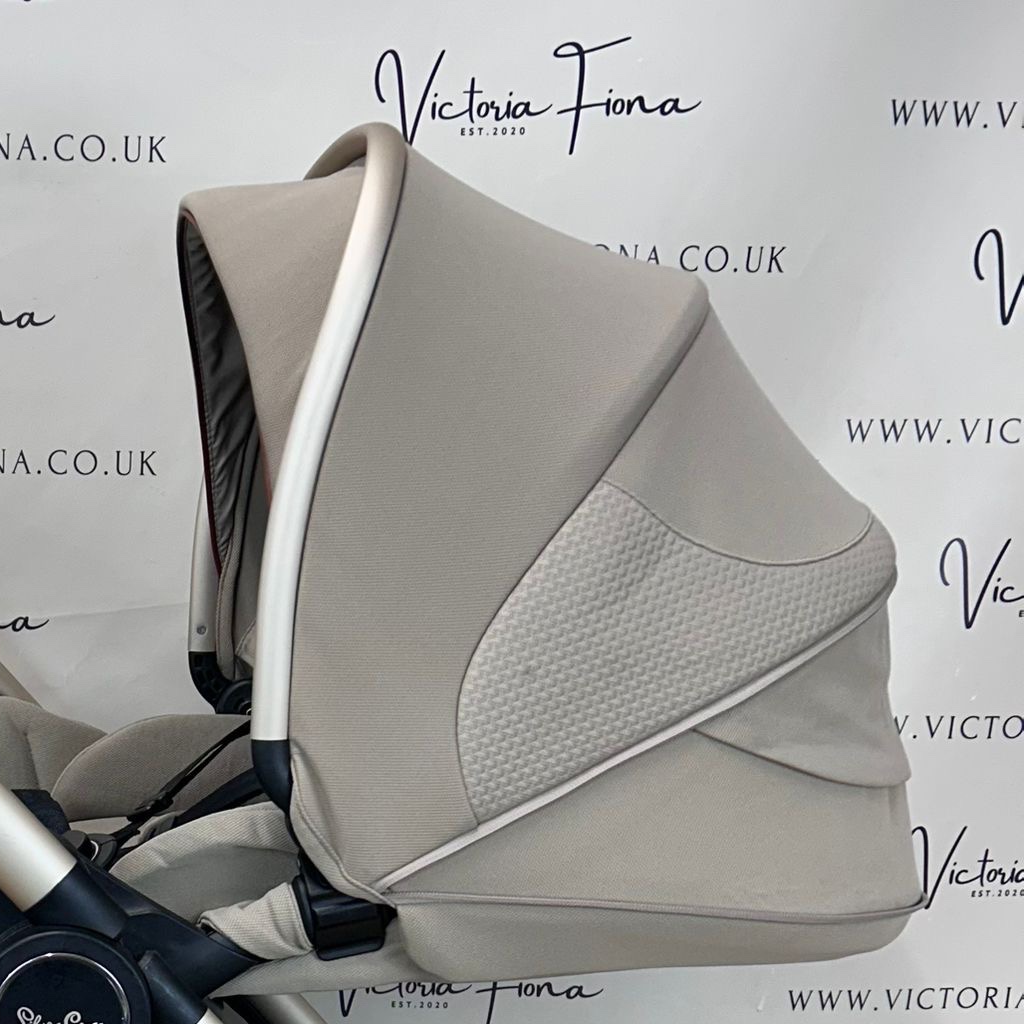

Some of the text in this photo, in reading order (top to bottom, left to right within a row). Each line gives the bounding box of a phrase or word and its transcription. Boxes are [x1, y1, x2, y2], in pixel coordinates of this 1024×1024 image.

[375, 36, 701, 155] Victoria Fiona
[459, 126, 527, 136] EST.2020
[391, 1001, 449, 1009] EST.2020
